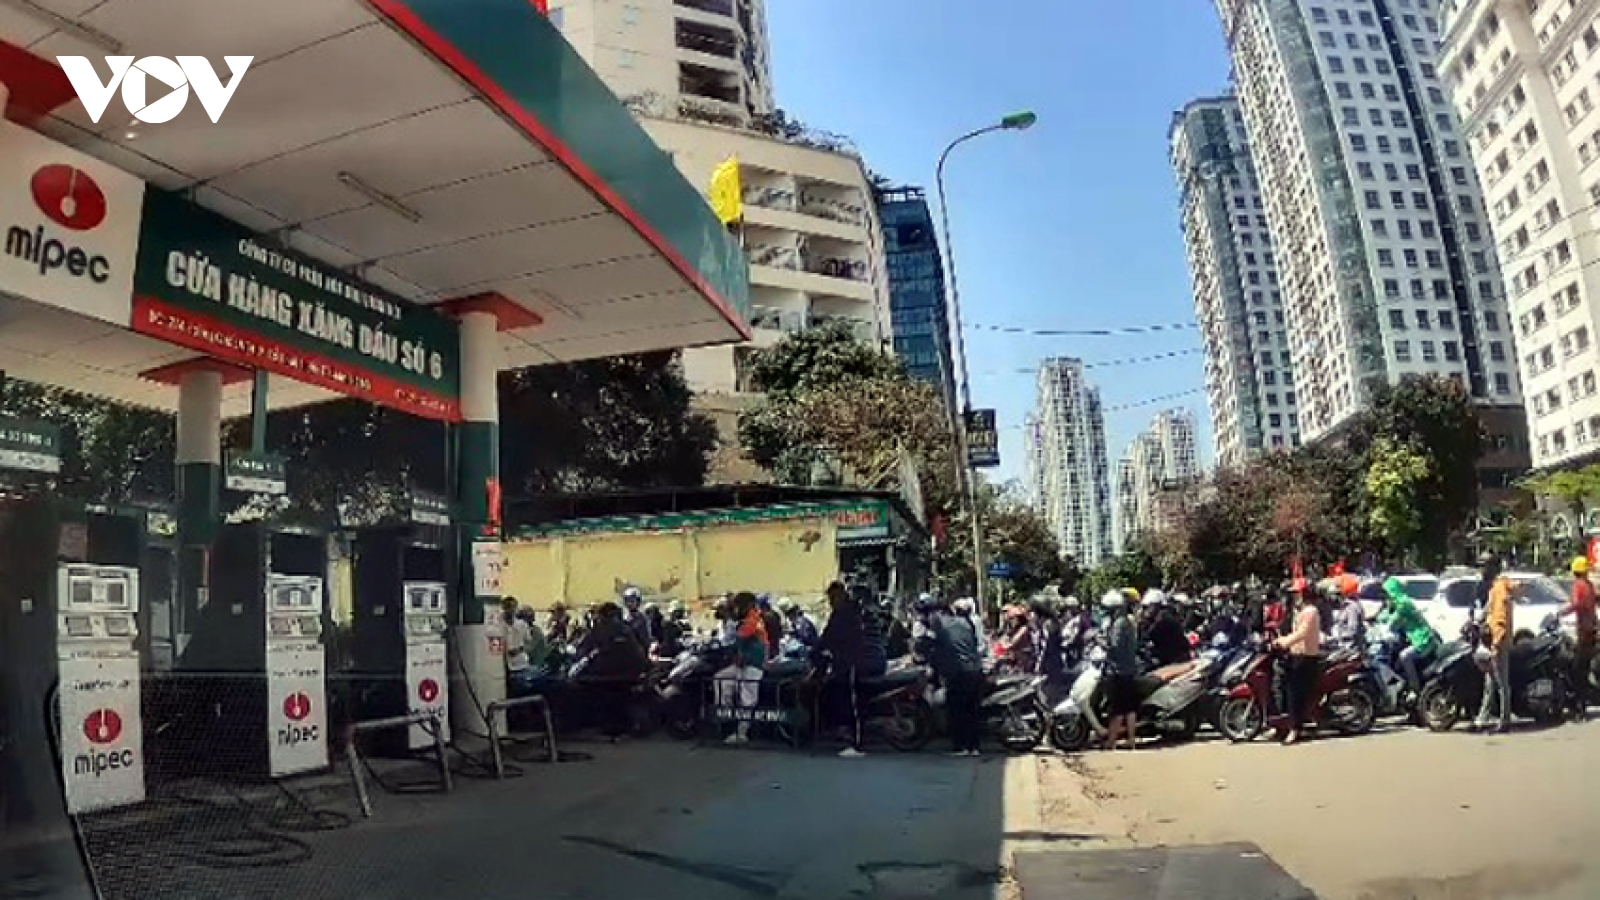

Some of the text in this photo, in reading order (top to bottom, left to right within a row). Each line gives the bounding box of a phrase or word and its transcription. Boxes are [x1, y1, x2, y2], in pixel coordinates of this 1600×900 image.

[5, 225, 110, 283] mipec
[166, 250, 221, 301] CỬA
[228, 272, 293, 328] HÀNG
[297, 300, 353, 349] XĂNG
[430, 351, 442, 380] 6
[74, 748, 134, 778] mipec
